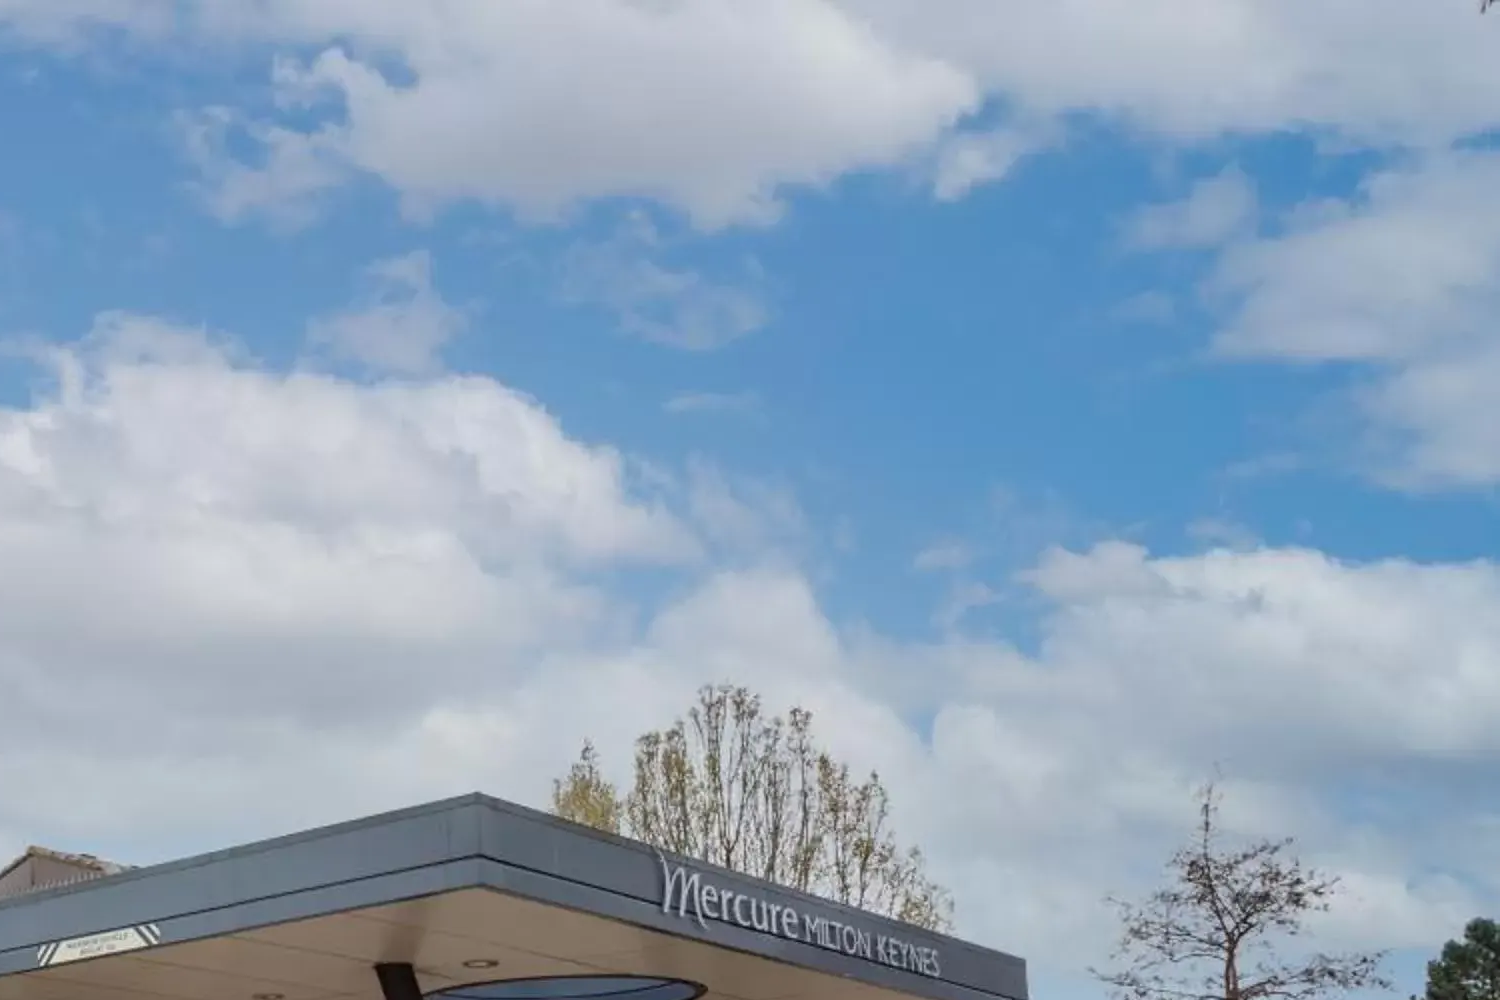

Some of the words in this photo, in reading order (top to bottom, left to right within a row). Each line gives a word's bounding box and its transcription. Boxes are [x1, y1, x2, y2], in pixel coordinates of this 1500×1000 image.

[658, 849, 799, 939] Mercure
[804, 914, 871, 959] MILTON
[877, 933, 941, 977] KEYNES
